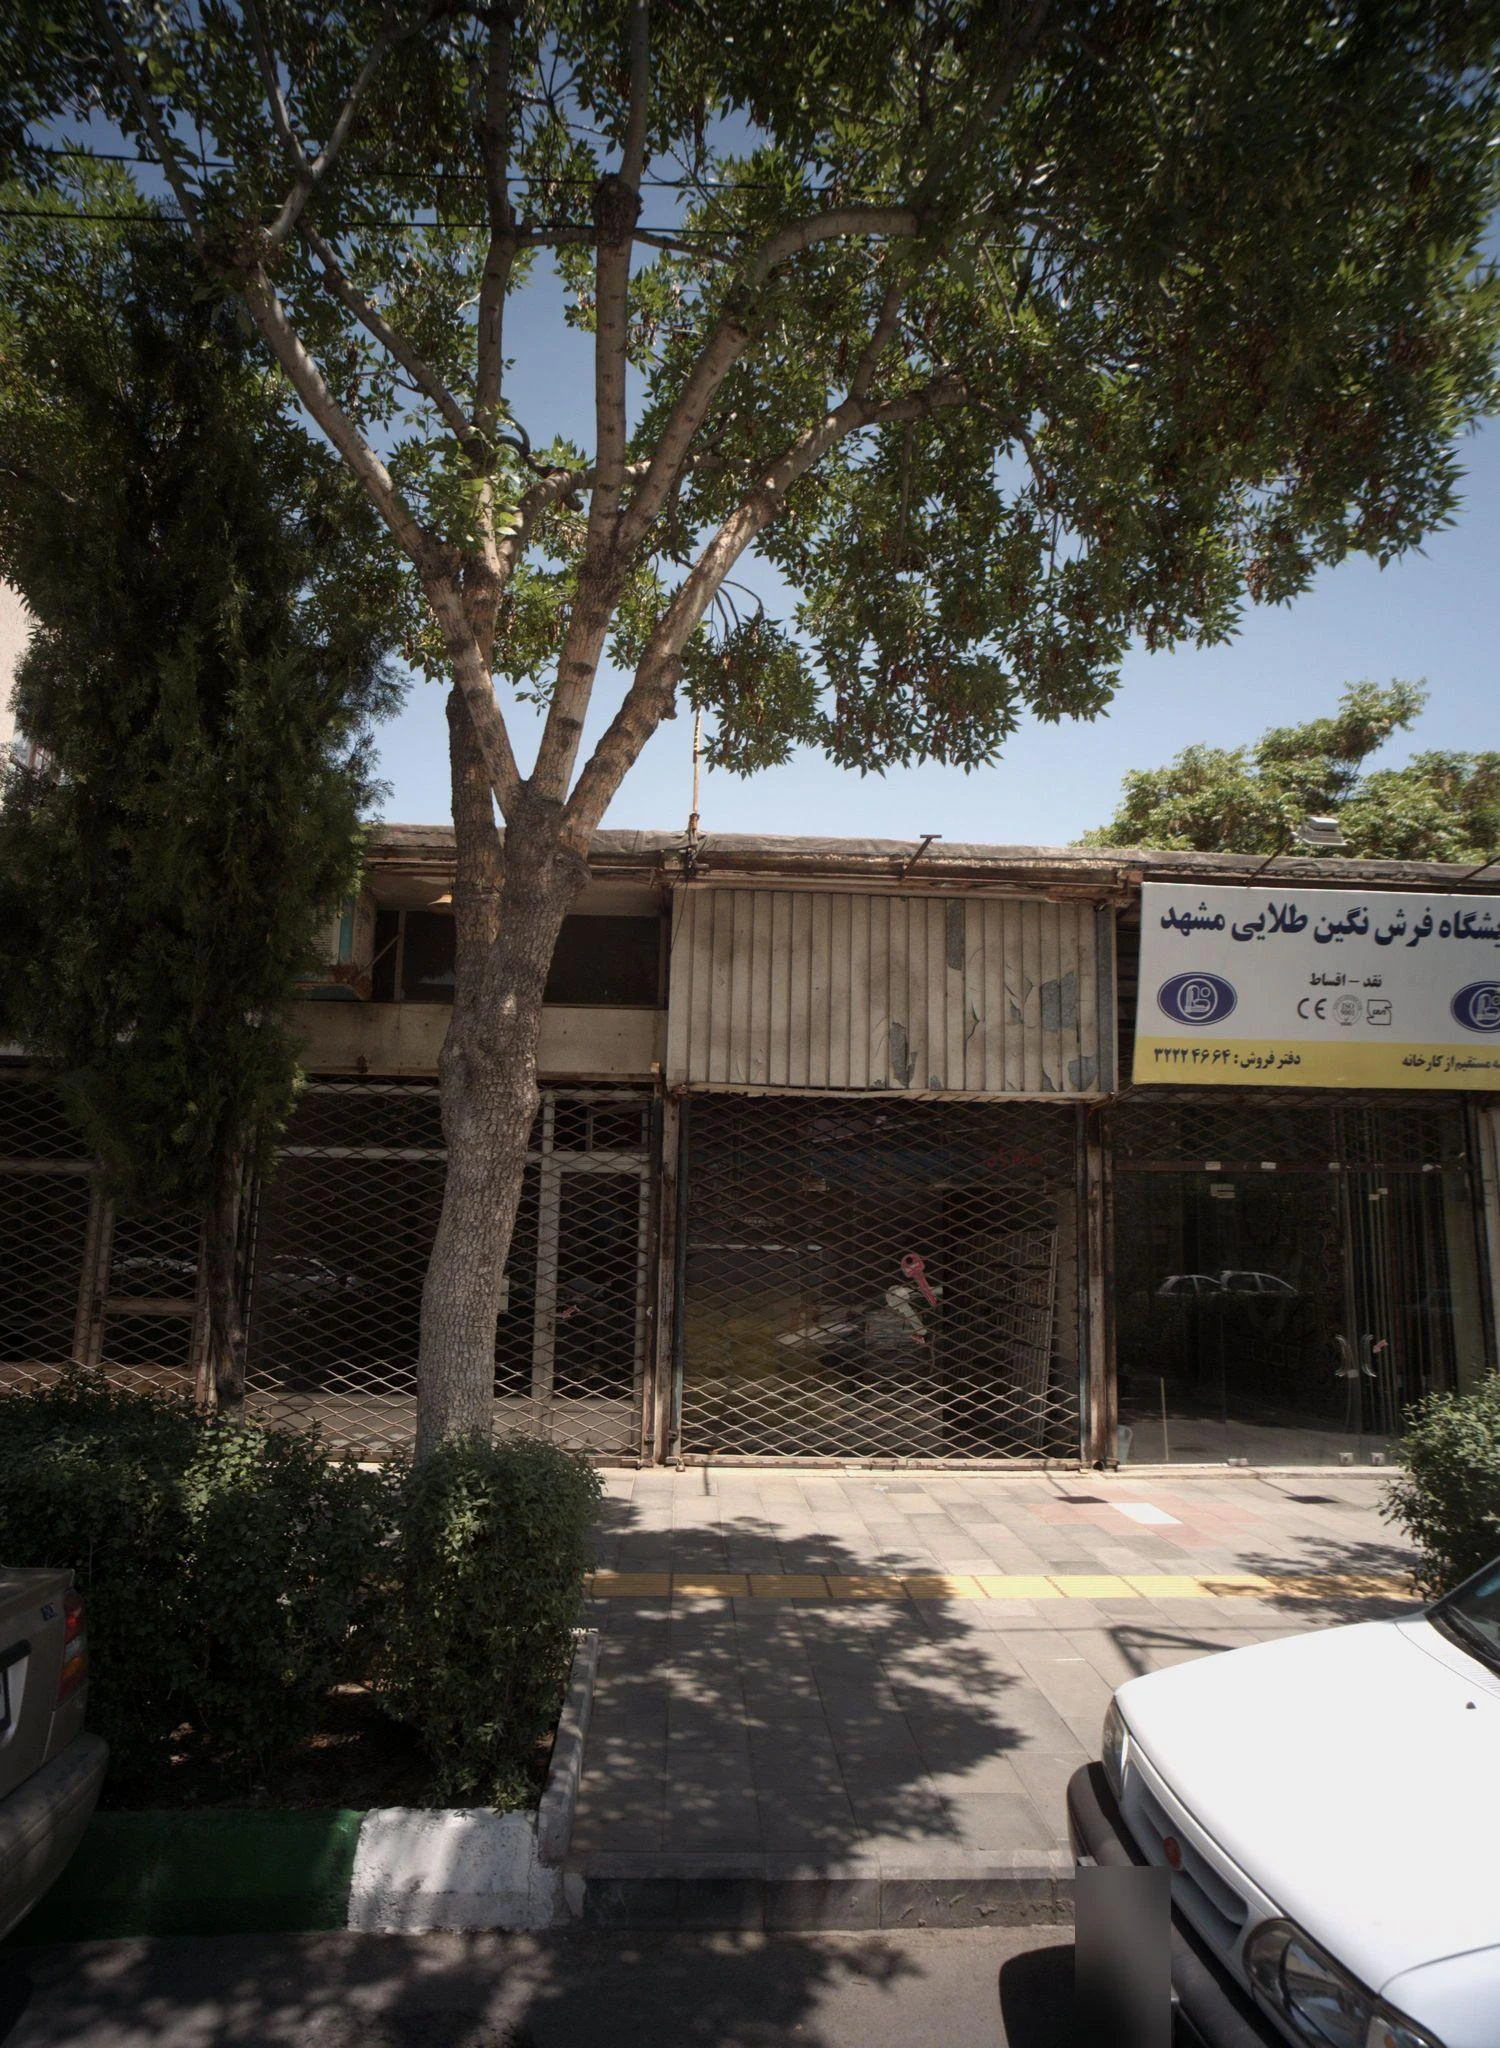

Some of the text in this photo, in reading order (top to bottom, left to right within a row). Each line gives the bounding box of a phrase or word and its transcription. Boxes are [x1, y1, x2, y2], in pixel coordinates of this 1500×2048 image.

[1160, 901, 1226, 937] مشهد
[1231, 902, 1309, 942] طلایی
[1313, 906, 1369, 944] نگین
[1374, 906, 1434, 948] فرش
[1309, 972, 1346, 987] اقساط
[1362, 974, 1383, 988] نقد
[1297, 997, 1328, 1020] CE
[1276, 1050, 1301, 1069] دفتر
[1444, 1055, 1455, 1073] از
